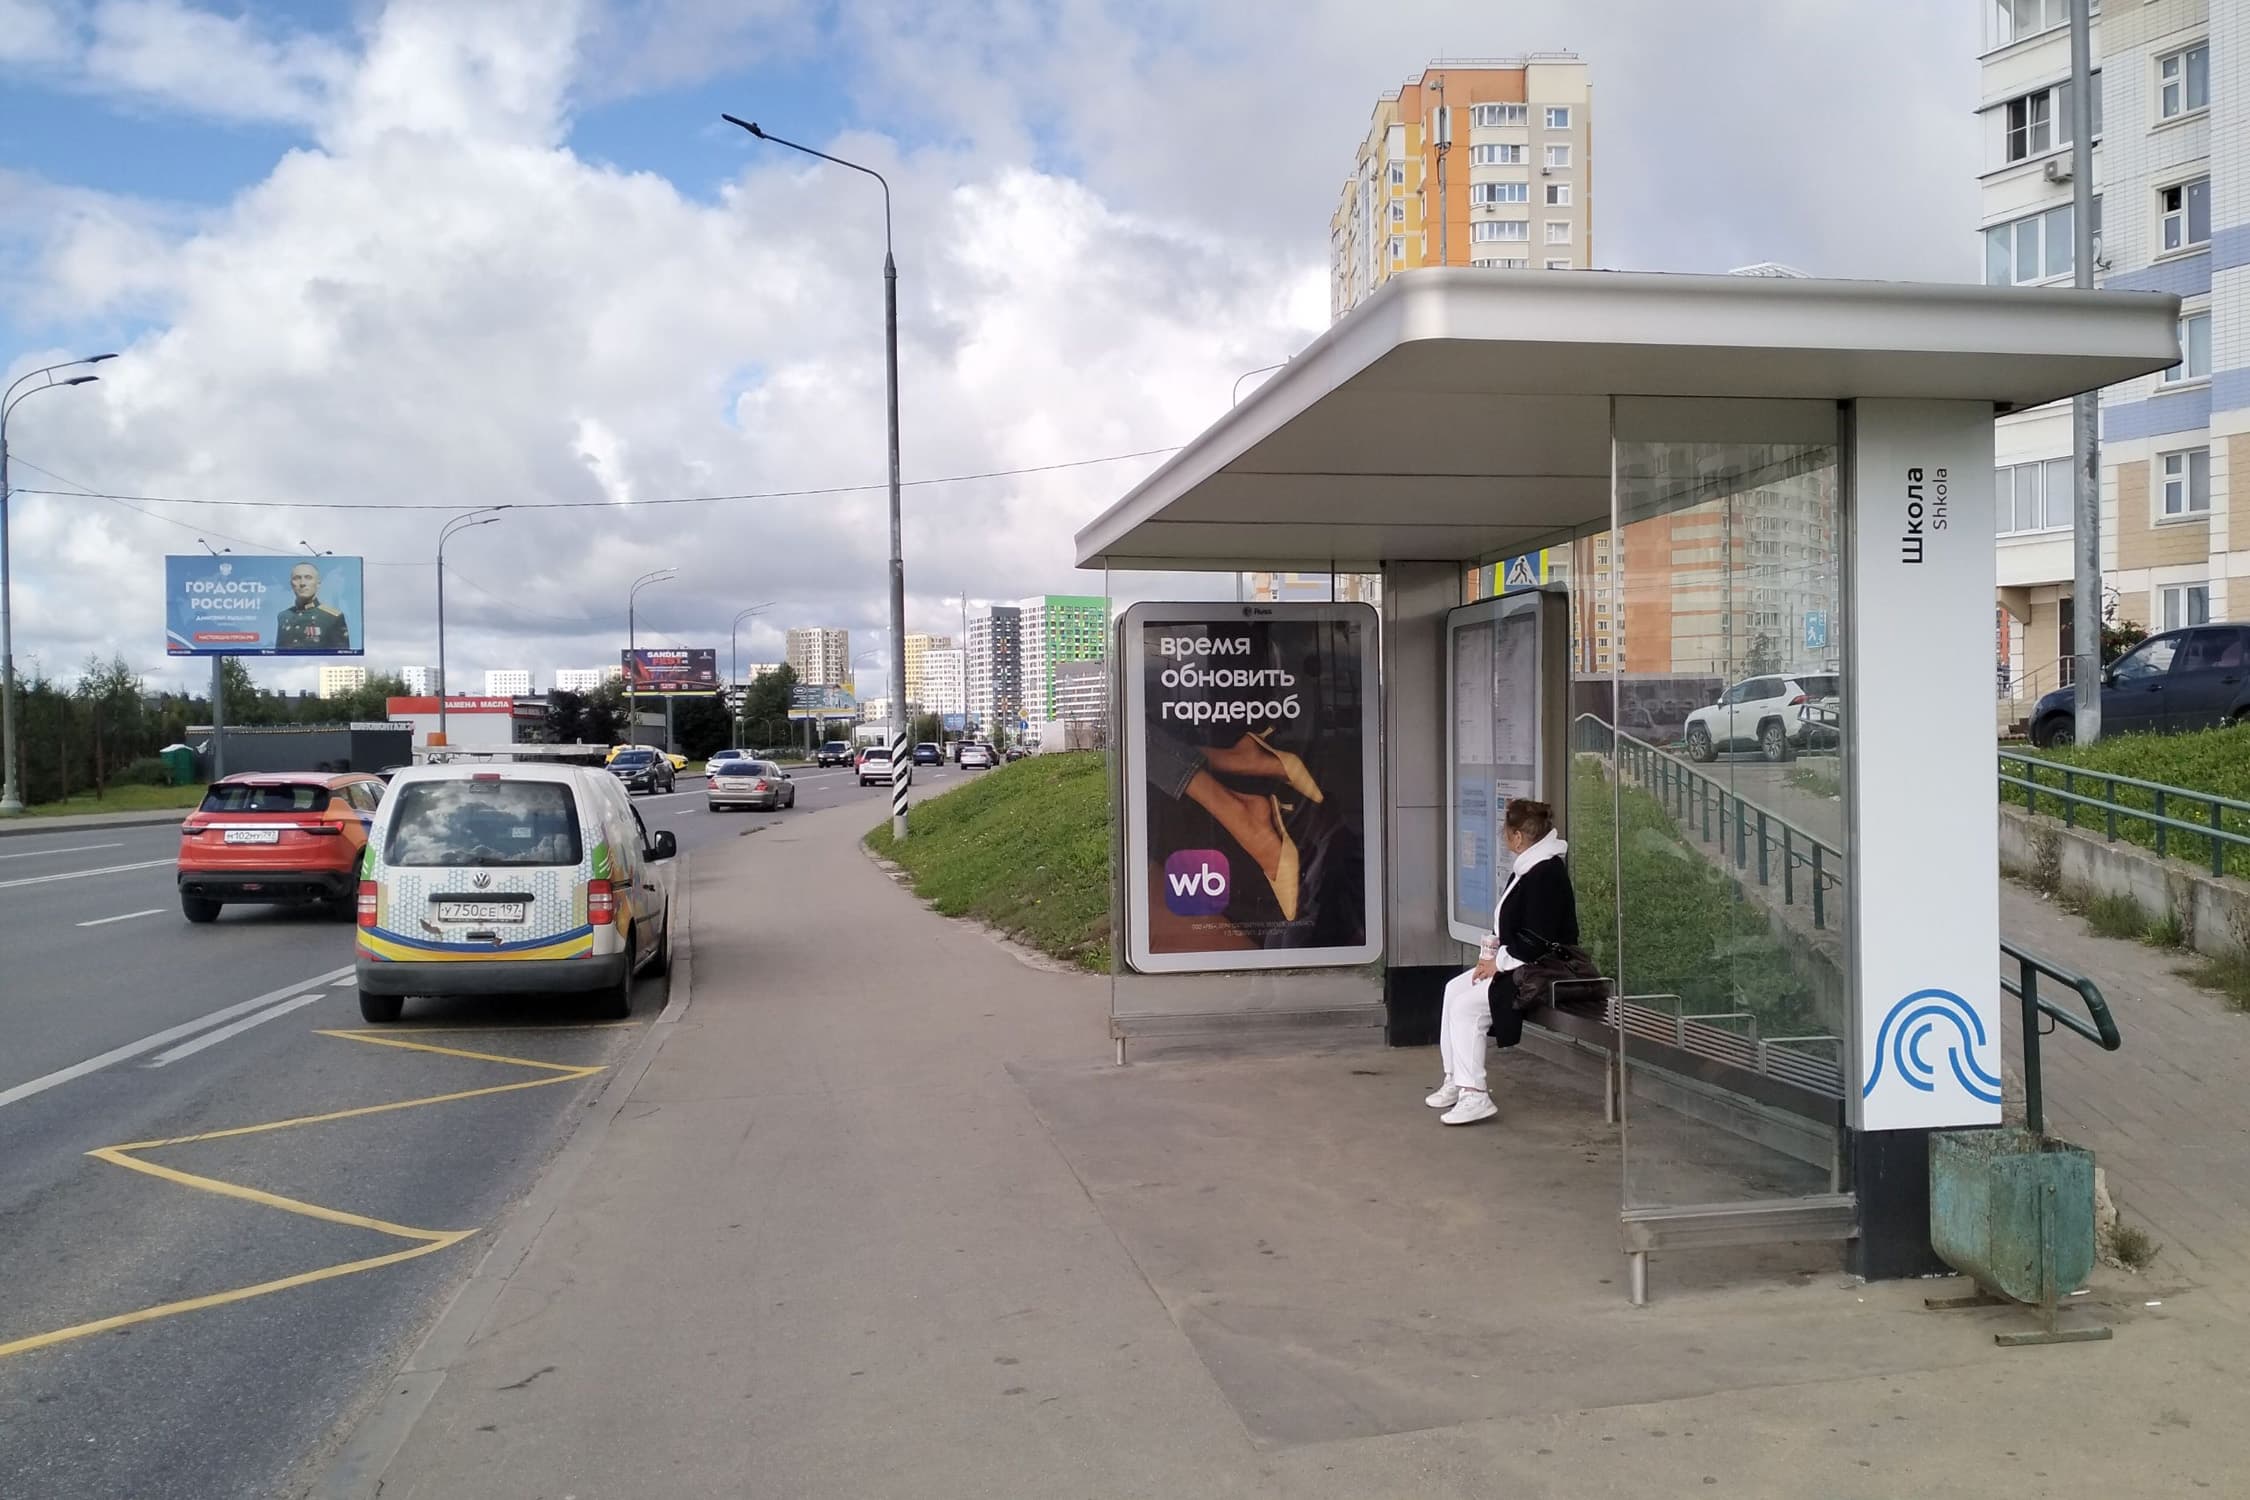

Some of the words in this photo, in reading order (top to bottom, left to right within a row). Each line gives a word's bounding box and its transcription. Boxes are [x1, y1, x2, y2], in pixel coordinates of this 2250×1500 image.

[1932, 468, 1947, 531] Shkola
[1902, 467, 1924, 564] Школа
[185, 581, 266, 595] ГОРДОСТЬ
[191, 597, 261, 610] РОССИИ!
[1254, 607, 1273, 615] Russ
[1160, 636, 1250, 661] время
[1161, 663, 1296, 689] обновить
[1161, 694, 1301, 724] гардероб
[1168, 862, 1226, 897] wb
[500, 904, 519, 913] 197
